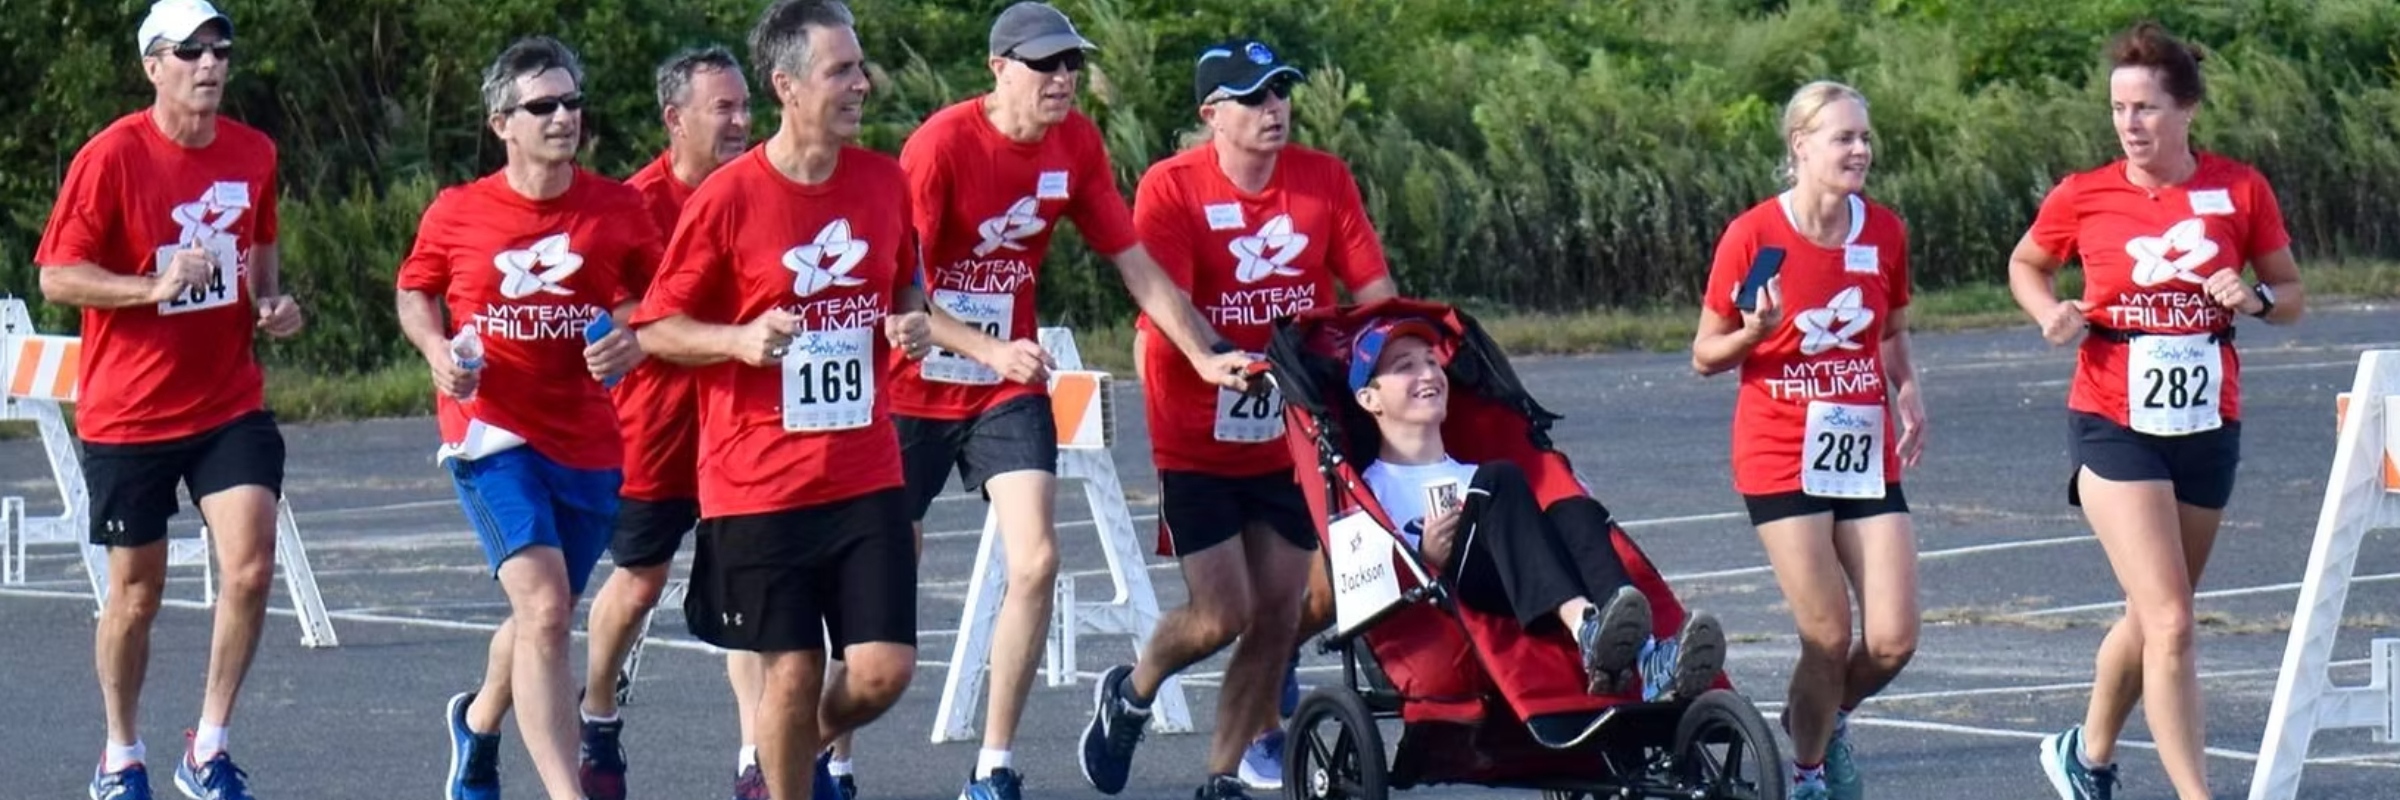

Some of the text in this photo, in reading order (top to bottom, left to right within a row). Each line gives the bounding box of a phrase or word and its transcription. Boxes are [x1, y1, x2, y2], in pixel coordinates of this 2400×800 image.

[1221, 283, 1315, 306] MYTEAM
[487, 303, 591, 320] MYTEAM
[1206, 298, 1315, 326] TRIUMP
[473, 313, 592, 340] TRIUMP
[799, 358, 862, 405] 169
[1783, 358, 1874, 378] MYTEAM
[2144, 365, 2209, 409] 282
[1813, 431, 1872, 474] 283
[1341, 563, 1386, 595] Jackson
